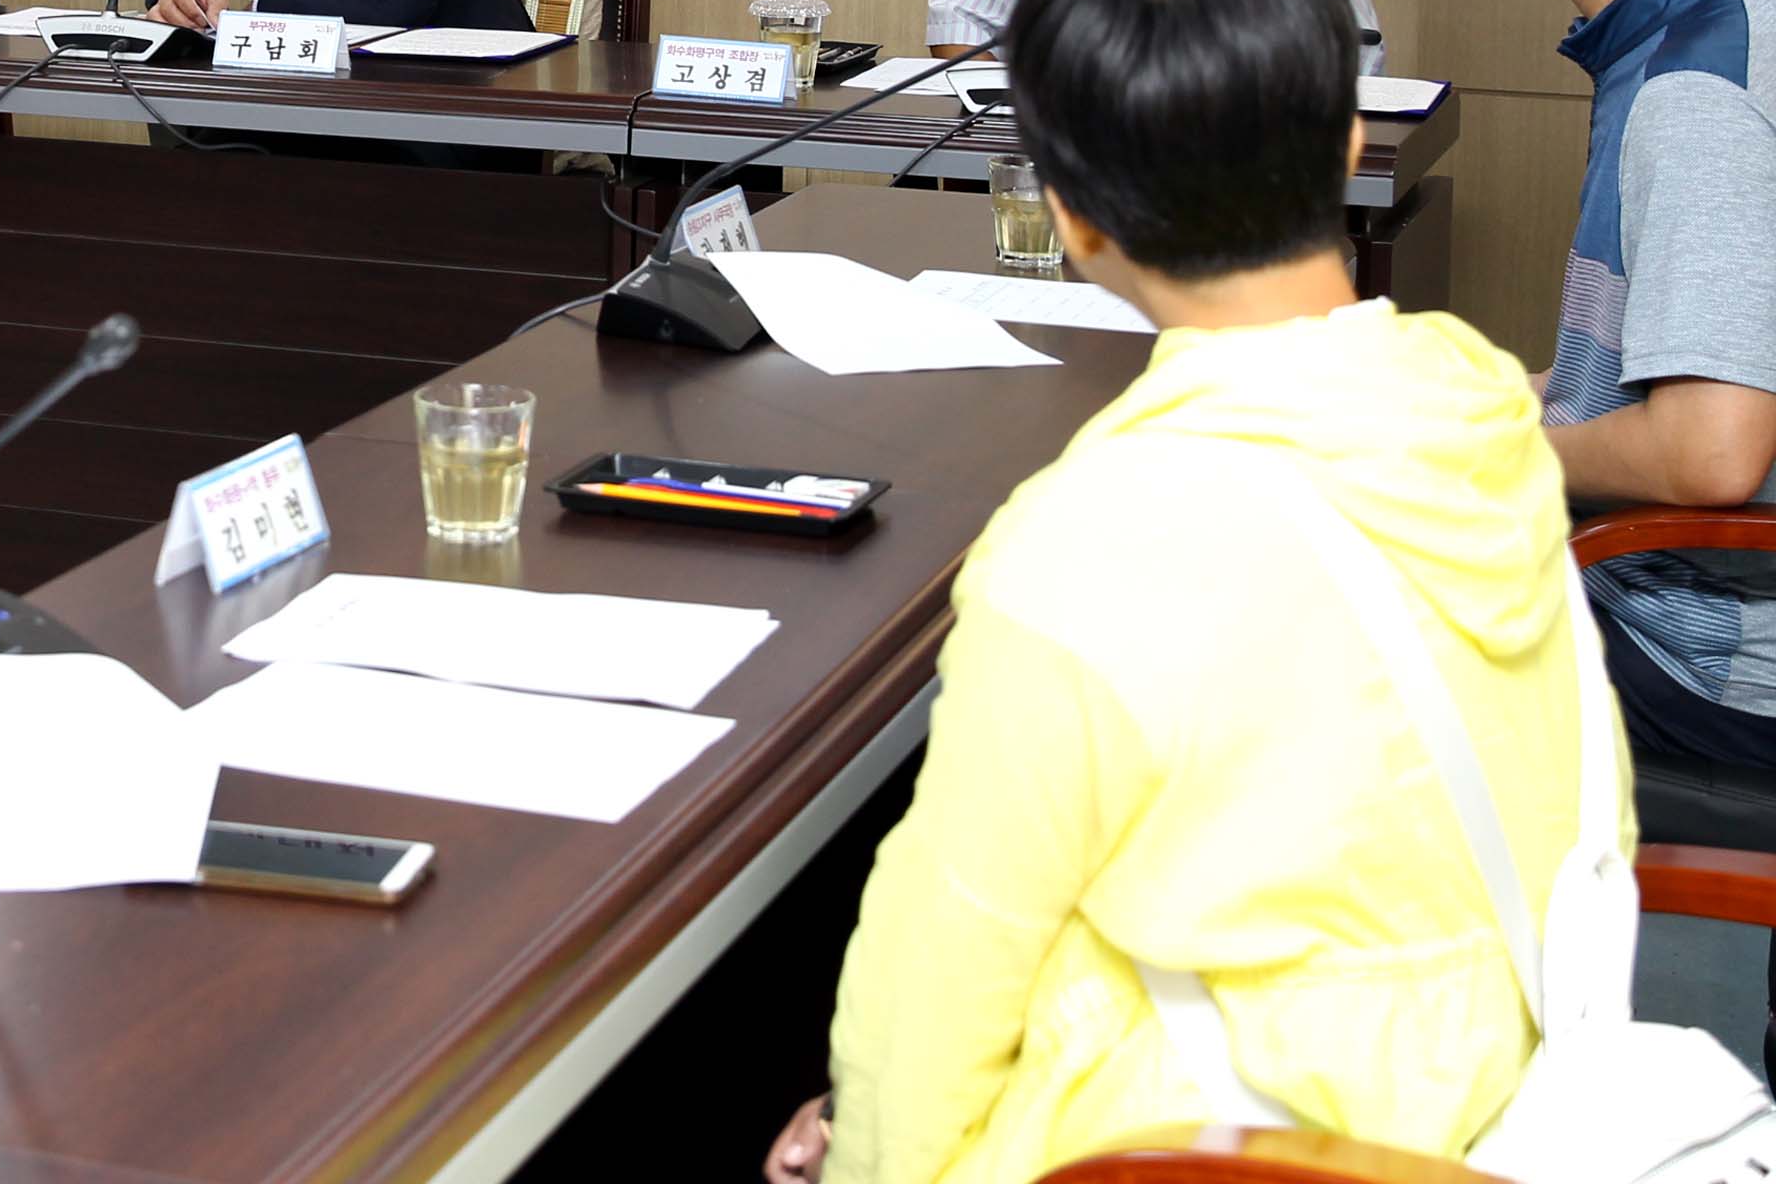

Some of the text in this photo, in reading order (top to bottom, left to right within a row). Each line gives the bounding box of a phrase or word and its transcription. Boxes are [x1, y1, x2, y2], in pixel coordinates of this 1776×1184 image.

[95, 23, 125, 33] BOSCH
[248, 19, 287, 34] 부구청장
[728, 49, 759, 62] 조합장
